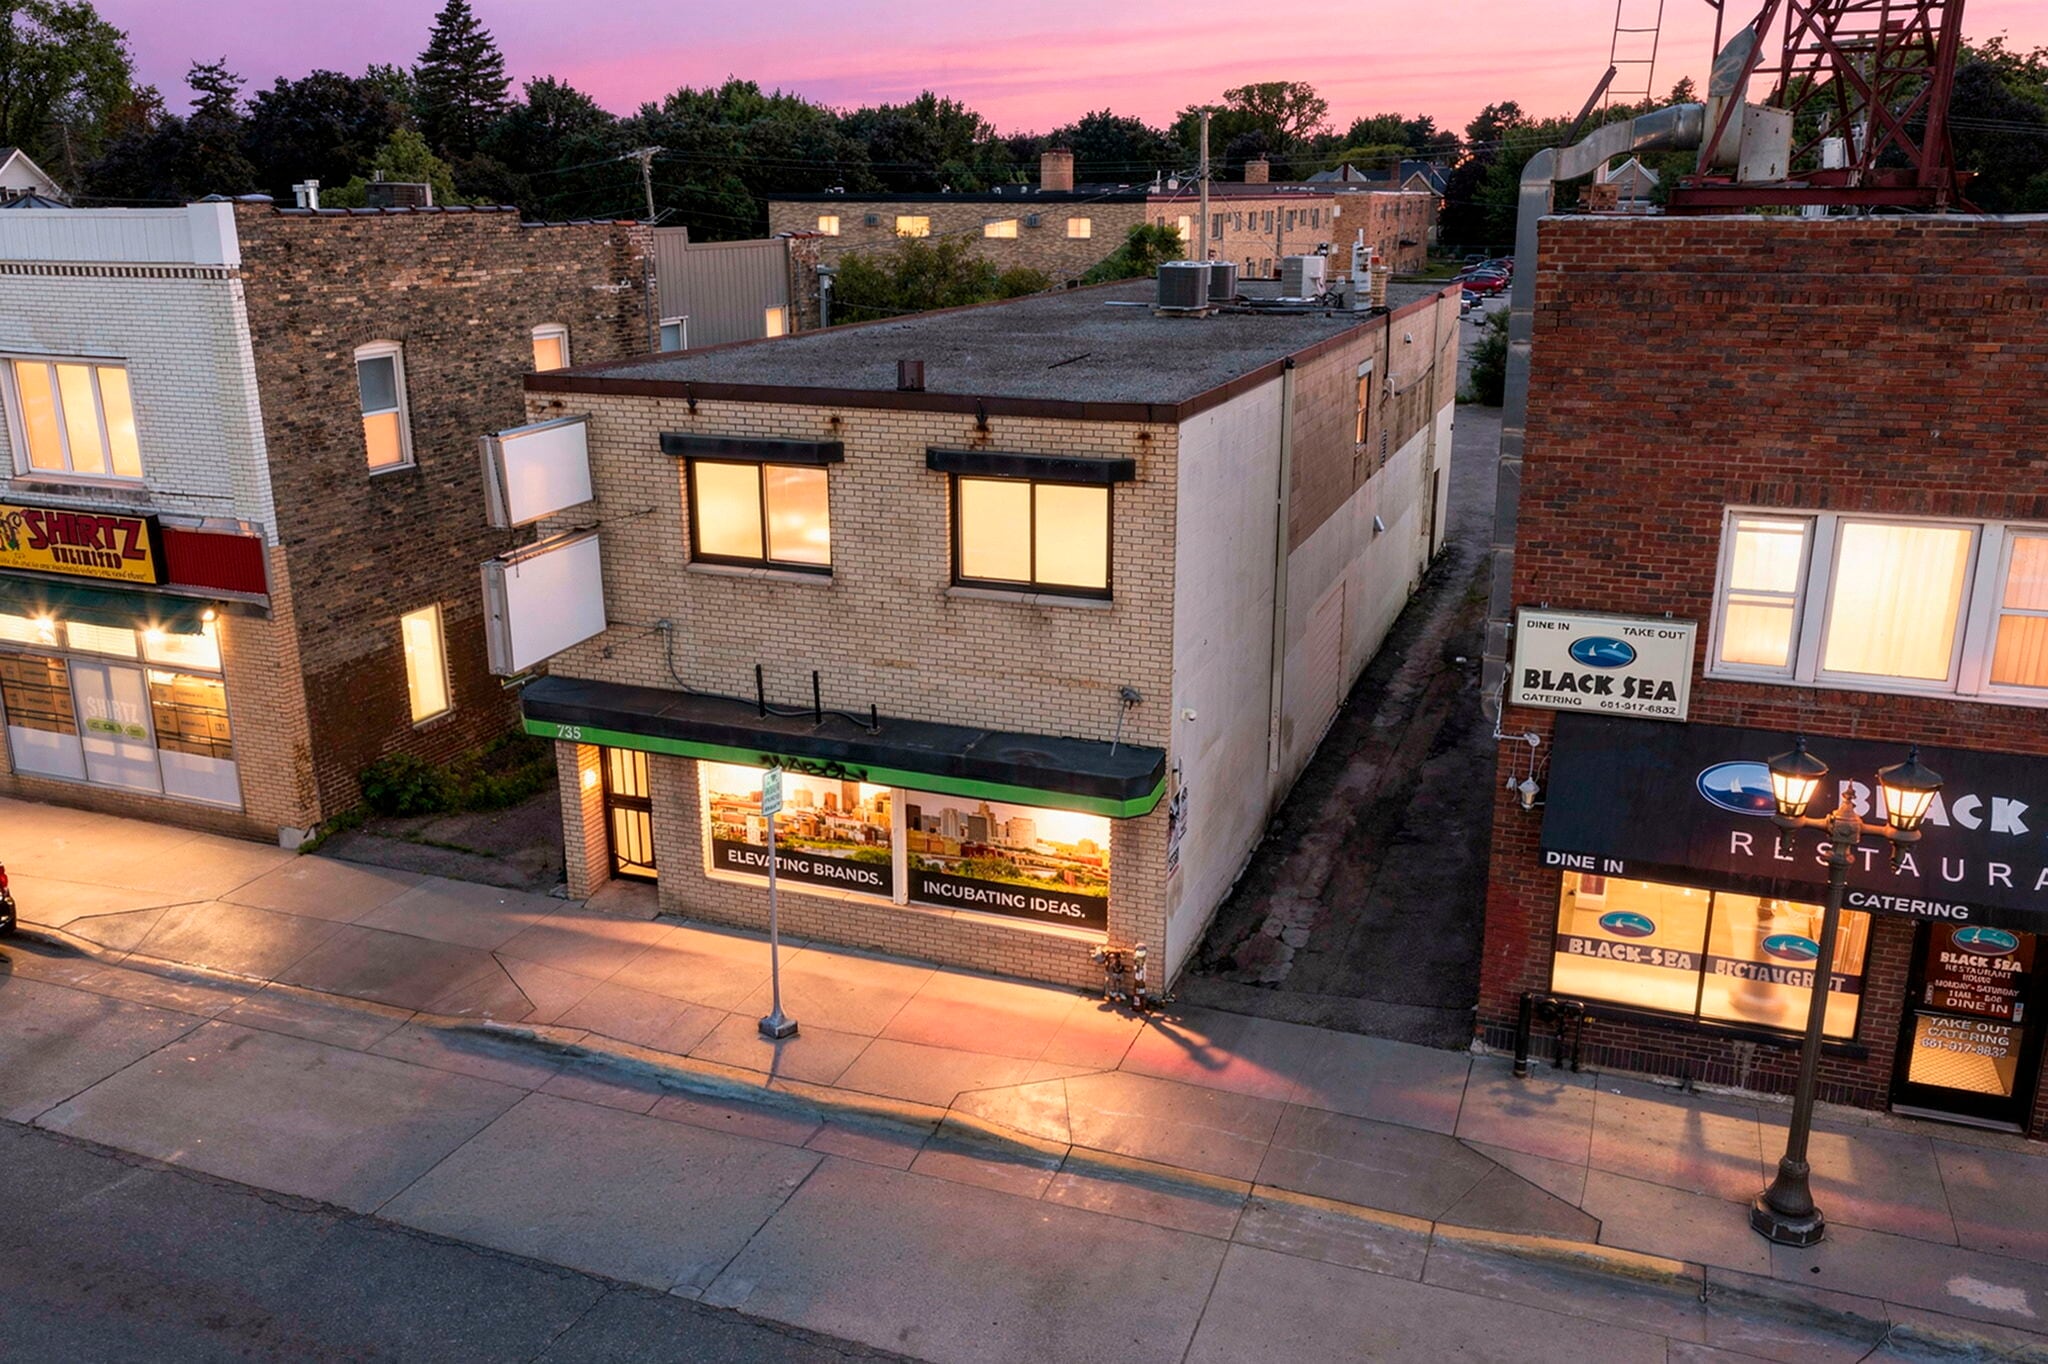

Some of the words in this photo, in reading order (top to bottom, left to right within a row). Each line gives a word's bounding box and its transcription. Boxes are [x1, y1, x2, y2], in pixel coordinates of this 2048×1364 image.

[20, 508, 147, 560] SHIRTZ
[1526, 619, 1555, 630] DINE
[1557, 622, 1570, 631] IN
[1622, 626, 1655, 638] TAKE
[1658, 630, 1686, 640] OUT
[1523, 669, 1615, 696] BLACK
[1621, 676, 1677, 702] SEA
[1522, 693, 1582, 706] CATERING
[557, 724, 581, 740] 735
[1546, 851, 1595, 870] DINE
[1603, 859, 1624, 874] IN
[813, 862, 883, 886] BRANDS.
[923, 880, 1026, 908] INCUBATING
[1030, 897, 1086, 919] IDEAS.
[1849, 892, 1969, 920] CATERING
[1940, 951, 1989, 968] BLACK
[1993, 958, 2022, 973] SEA
[1946, 998, 1986, 1011] DINE
[1991, 1004, 2008, 1014] IN
[1931, 1017, 1972, 1030] TAKE
[1976, 1023, 2012, 1035] OUT
